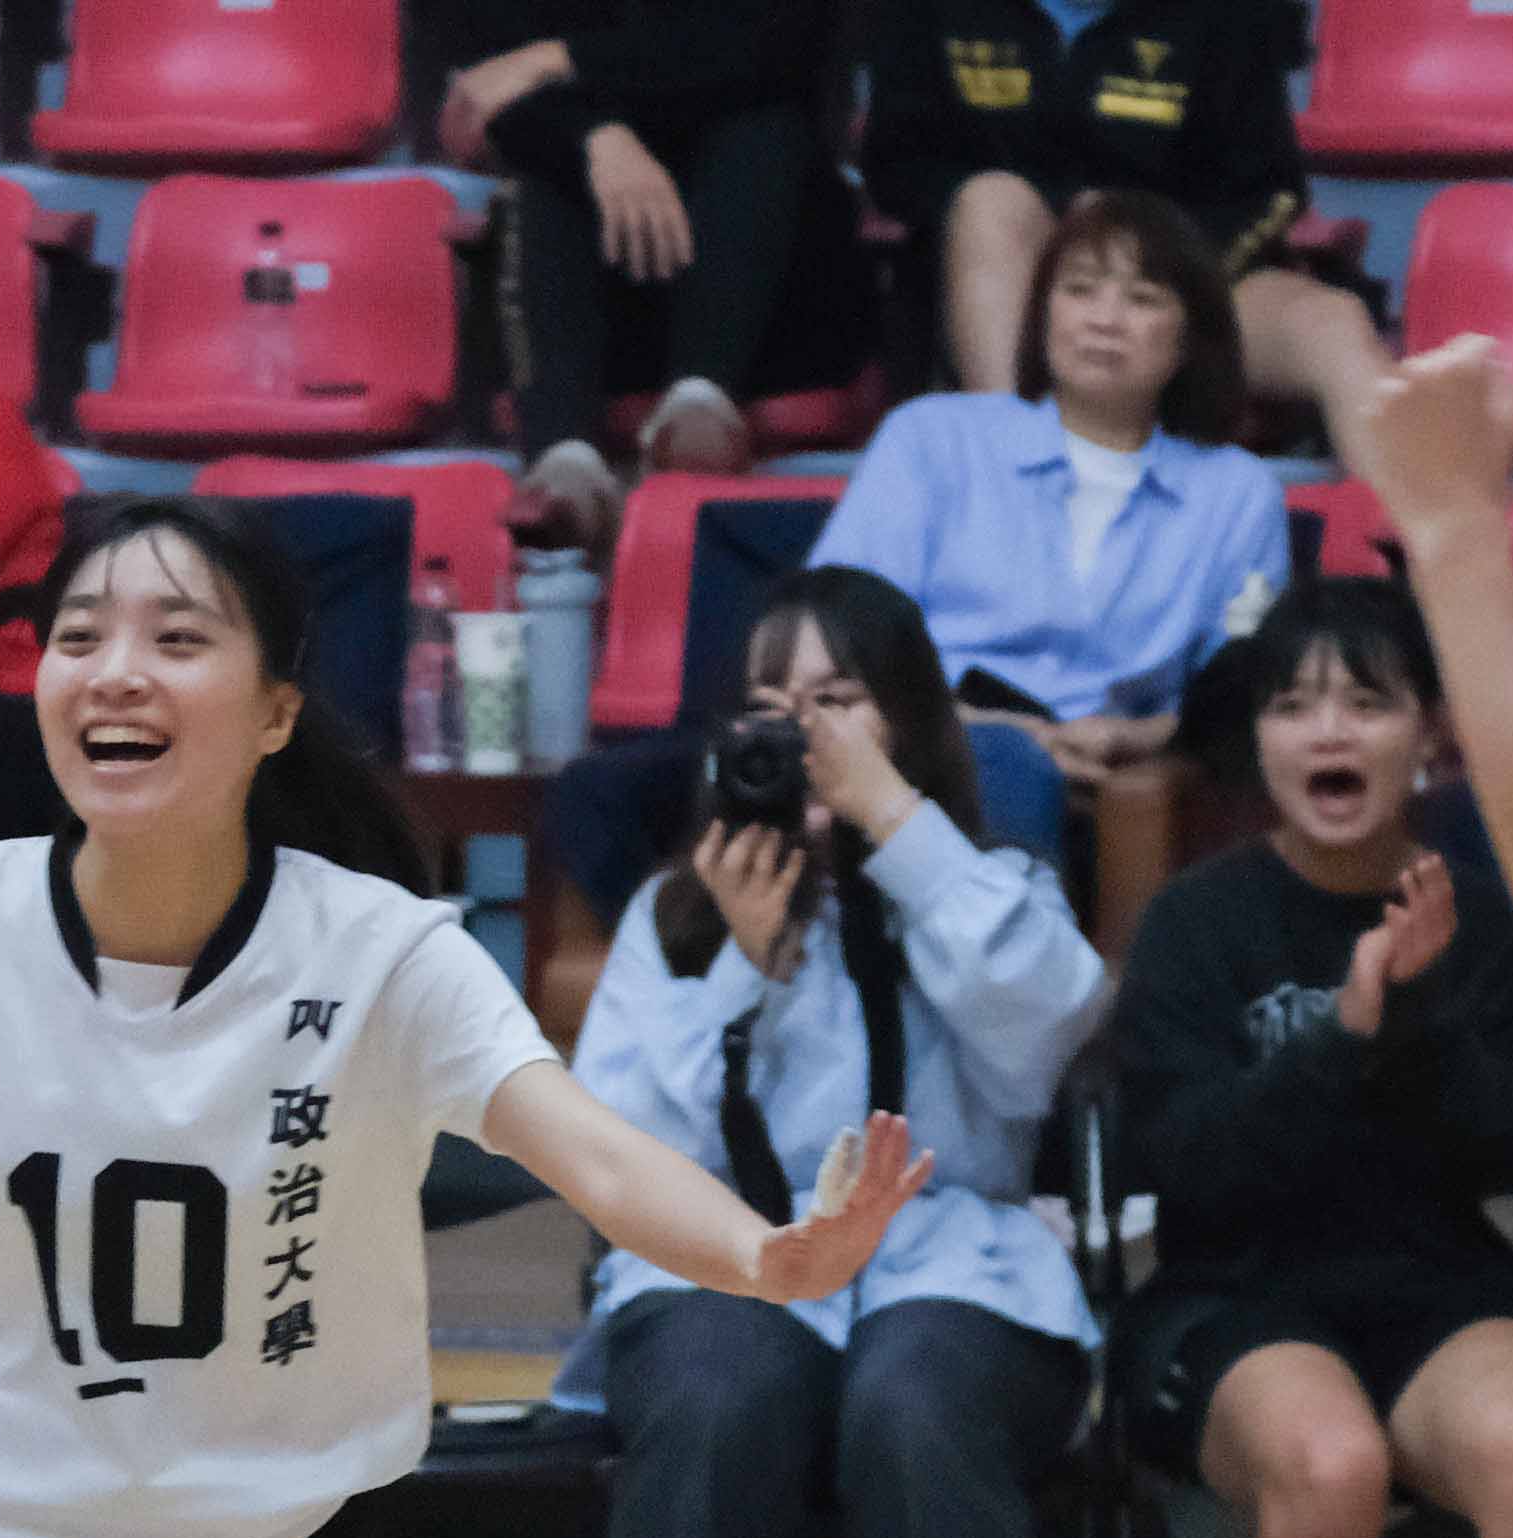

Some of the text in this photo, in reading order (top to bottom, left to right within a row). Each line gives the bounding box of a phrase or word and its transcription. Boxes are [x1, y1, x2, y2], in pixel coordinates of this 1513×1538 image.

[8, 1151, 229, 1367] 10
[260, 1083, 332, 1366] 政治大學
